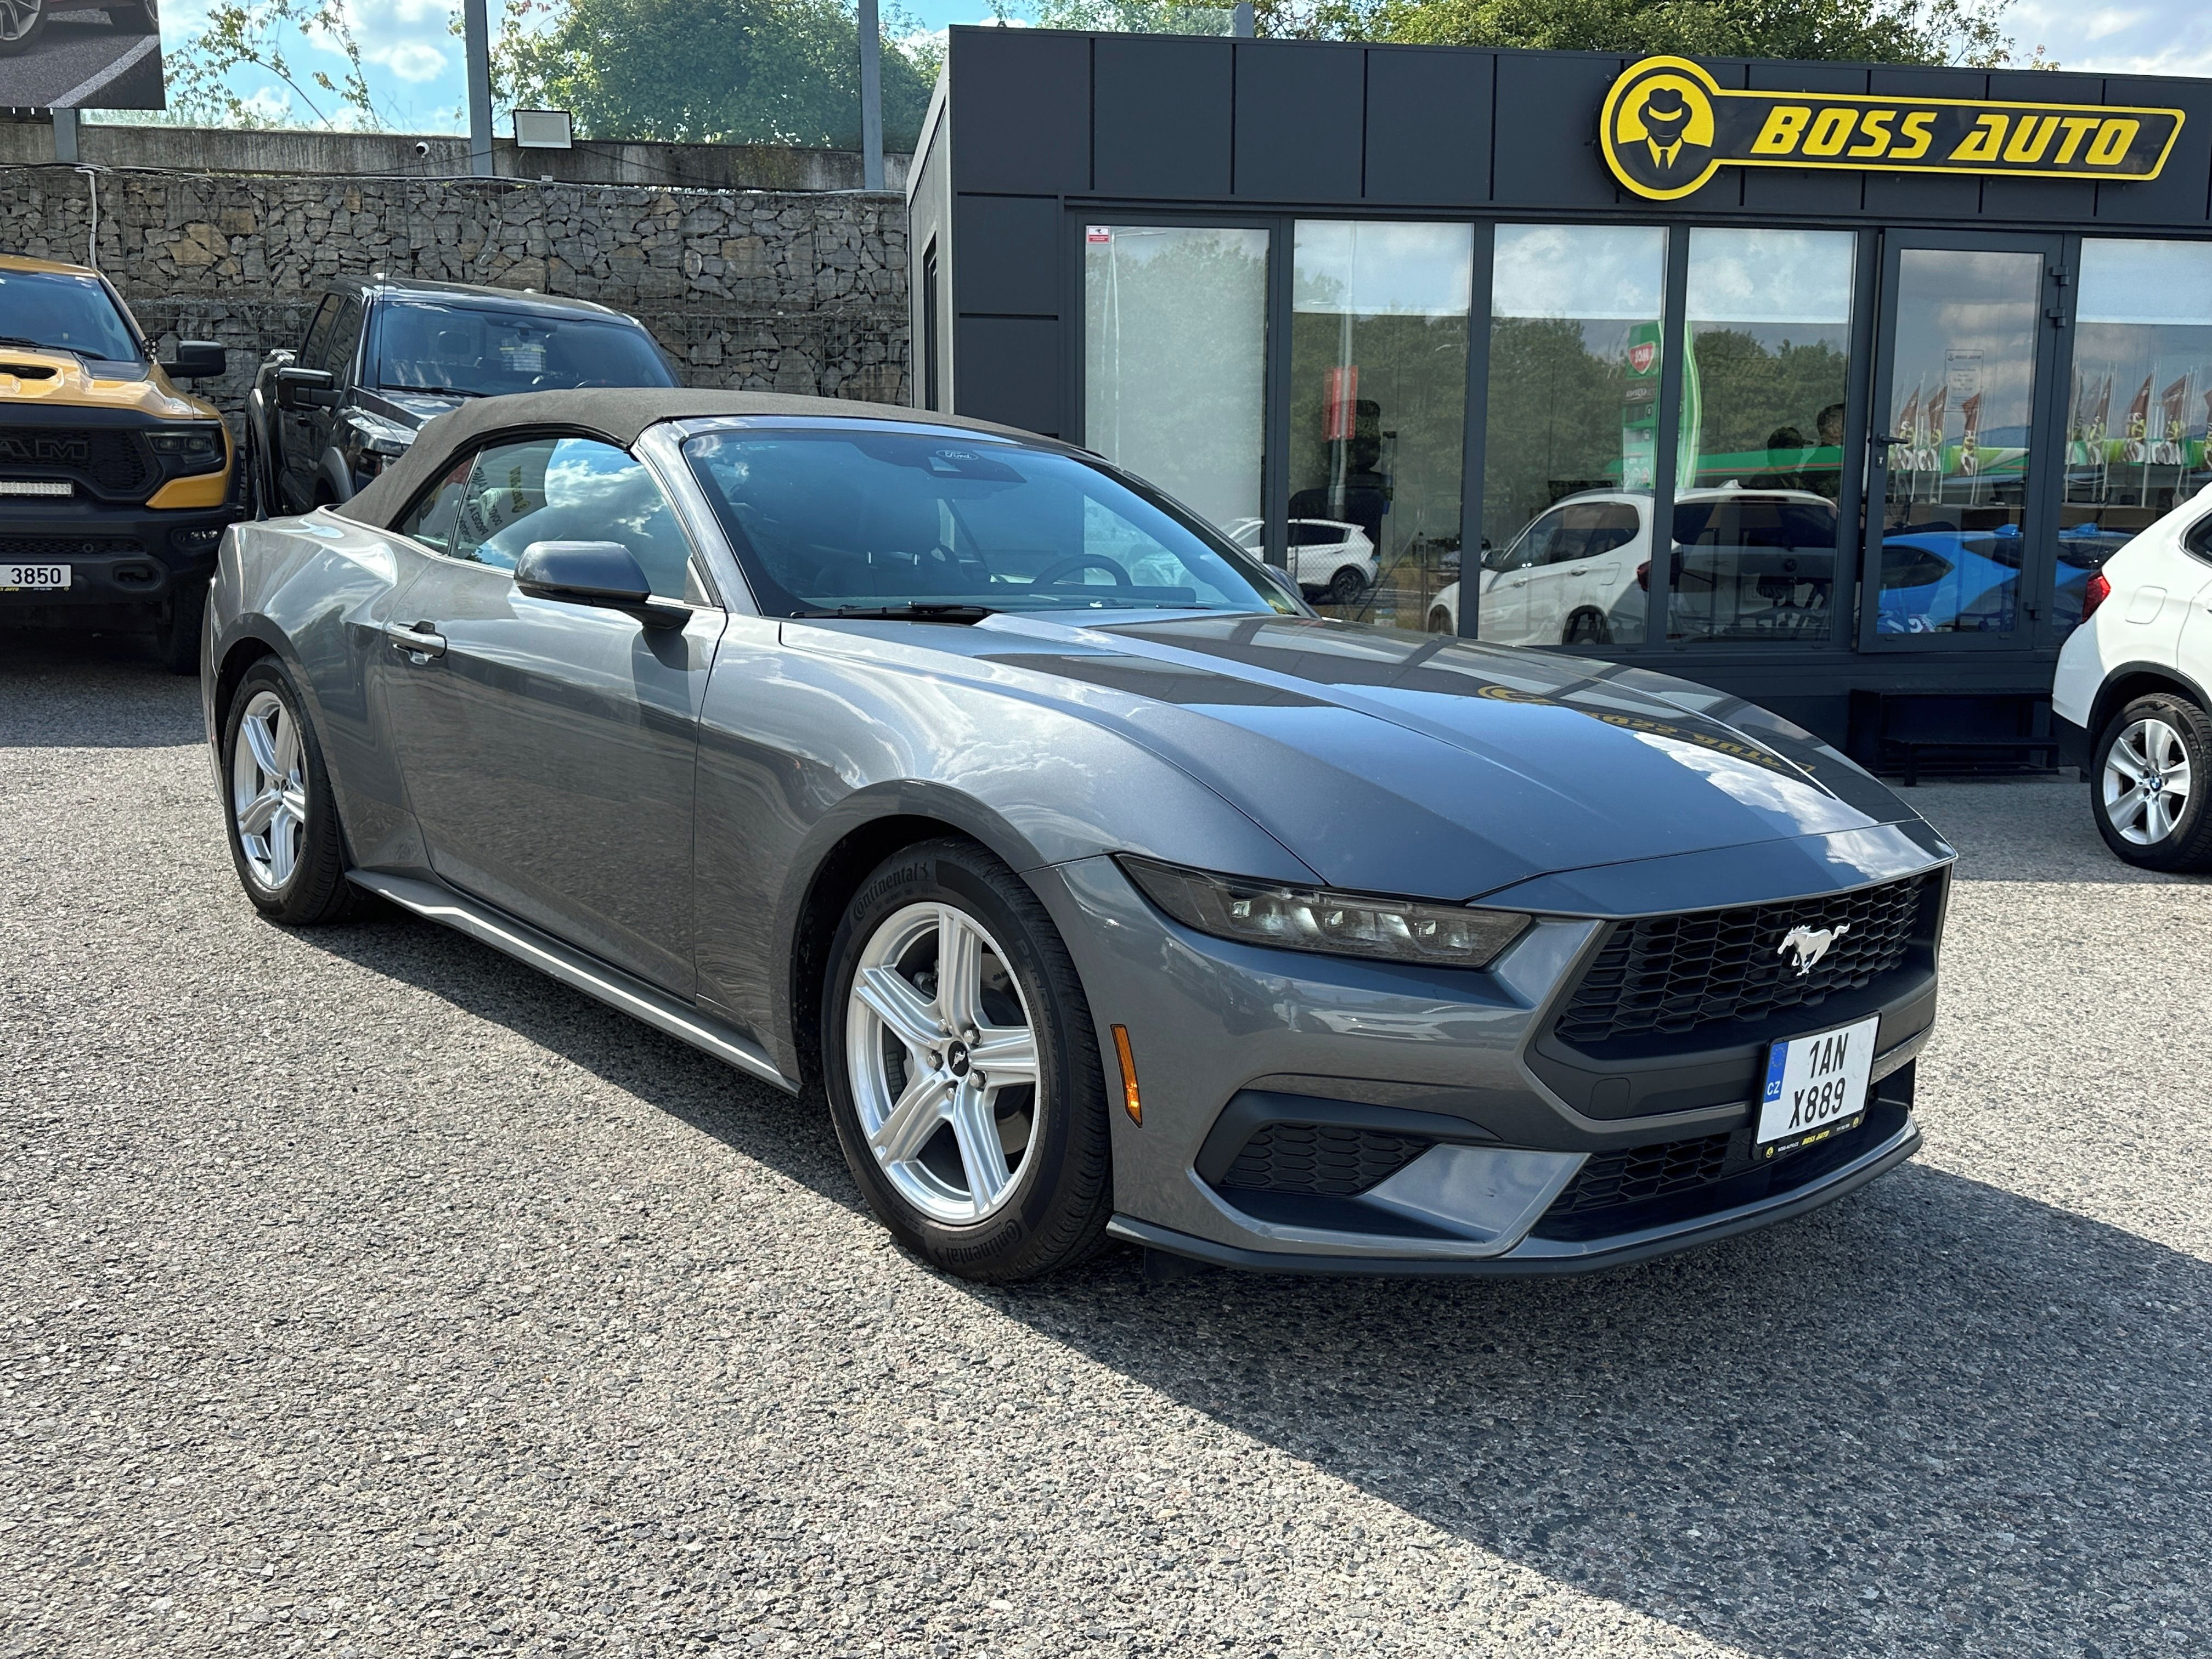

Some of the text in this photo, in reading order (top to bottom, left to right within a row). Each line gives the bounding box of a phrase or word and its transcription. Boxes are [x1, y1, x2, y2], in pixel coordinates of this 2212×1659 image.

[1749, 106, 2141, 165] BOSS AUTO
[11, 567, 61, 585] 3850
[853, 862, 918, 922] Continental
[1809, 1032, 1849, 1079] 1AN
[1767, 1080, 1781, 1096] CZ
[1788, 1077, 1846, 1129] X889
[945, 1219, 1023, 1265] Continental
